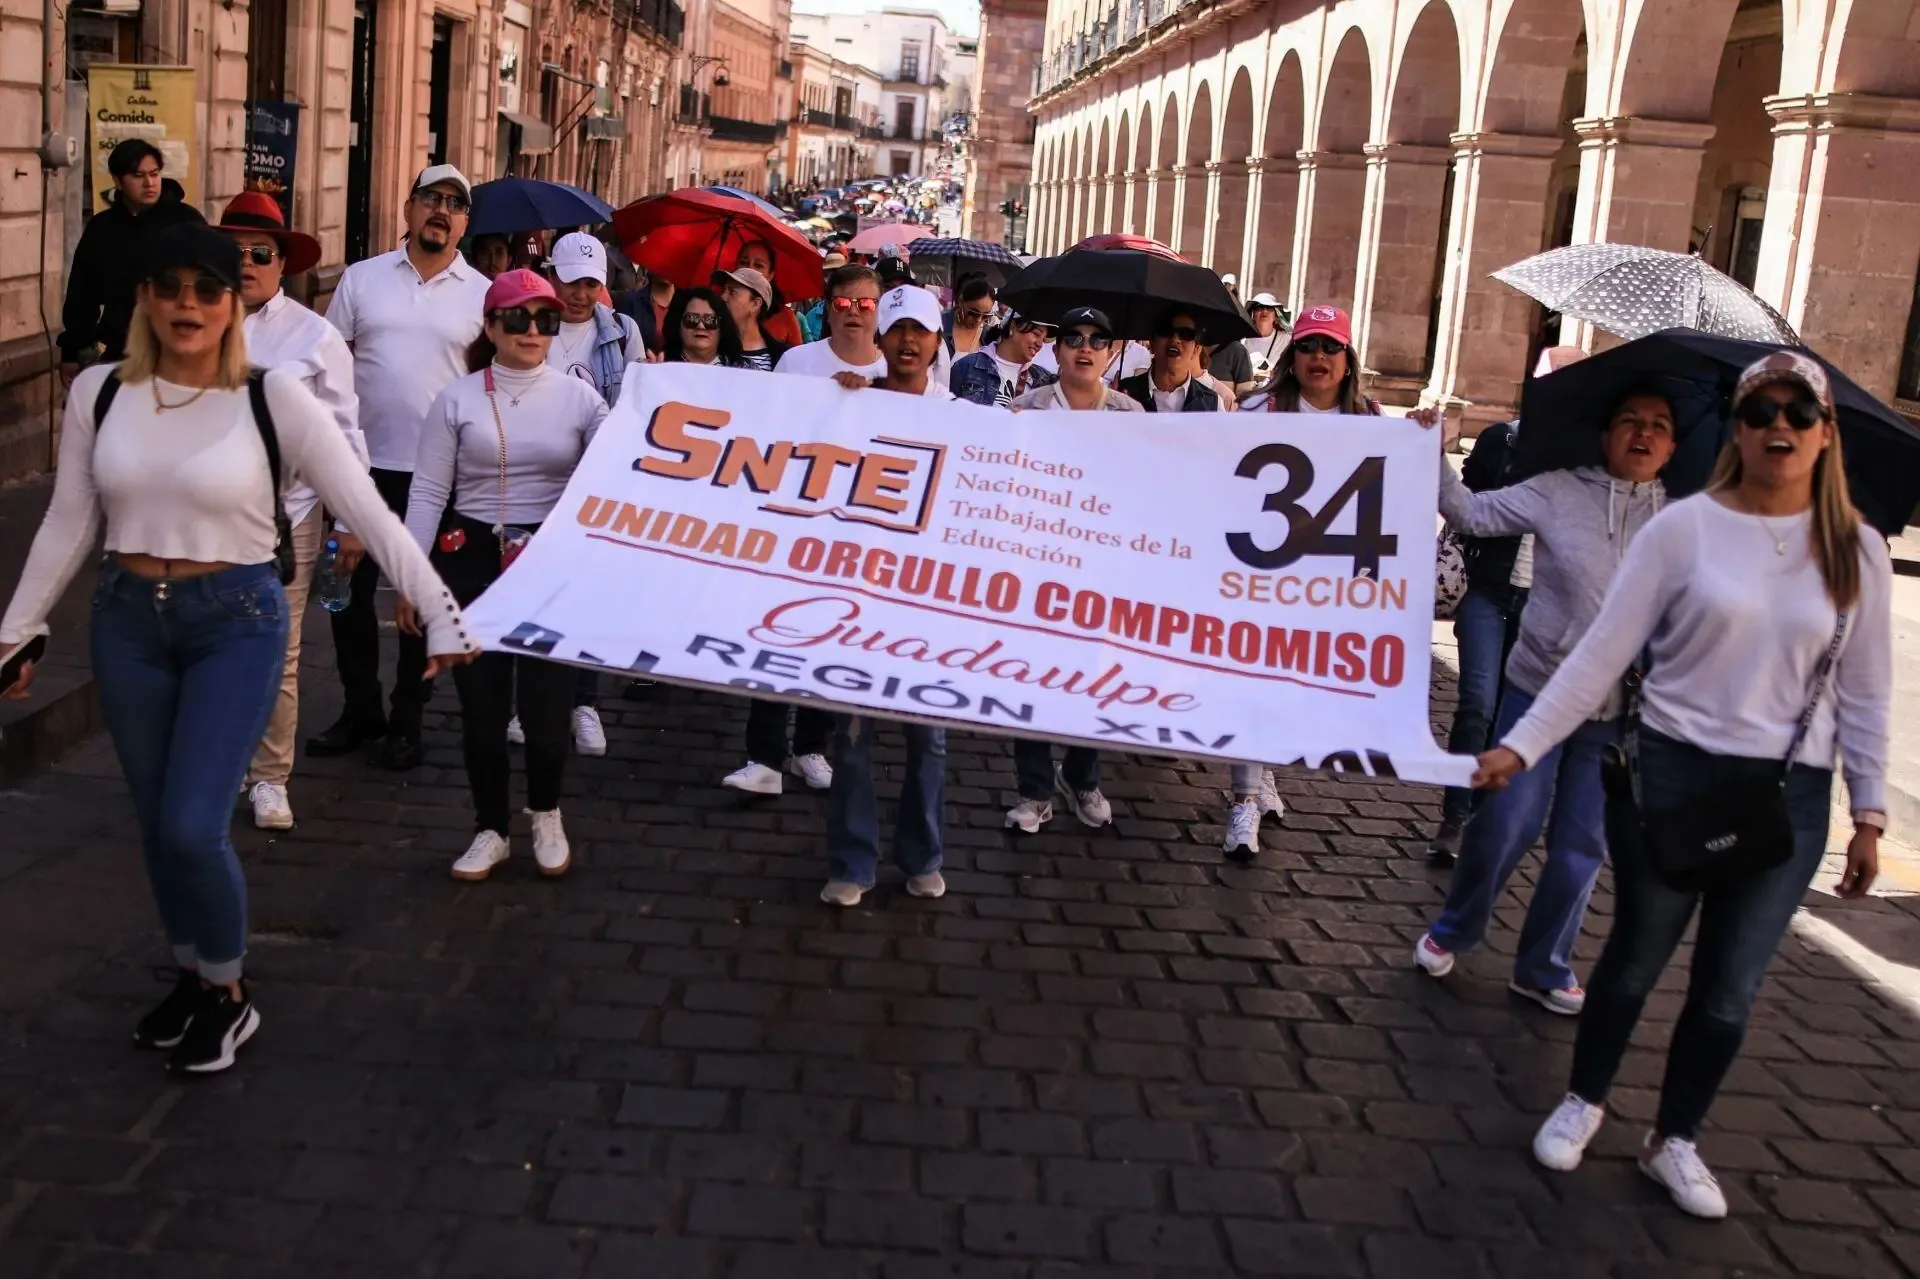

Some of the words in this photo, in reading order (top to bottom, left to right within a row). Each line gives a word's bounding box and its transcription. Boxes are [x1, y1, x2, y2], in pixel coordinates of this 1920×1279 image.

[97, 109, 155, 123] Comida
[632, 401, 918, 515] SNTE
[960, 445, 1084, 480] Sindicato
[954, 472, 1073, 508] Nacional
[1079, 495, 1113, 516] de
[1225, 443, 1399, 583] 34
[940, 526, 1083, 570] Educación
[949, 499, 1122, 548] Trabajadores
[1129, 533, 1162, 555] de
[1167, 536, 1193, 560] la
[576, 495, 778, 564] UNIDAD
[787, 536, 1022, 614] ORGULLO
[1034, 581, 1405, 688] COMPROMISO
[1218, 567, 1408, 611] SECCIÓN
[746, 596, 1202, 712] Guadaulpe
[685, 633, 1034, 724] REGIÓN
[1094, 716, 1237, 749] XIV
